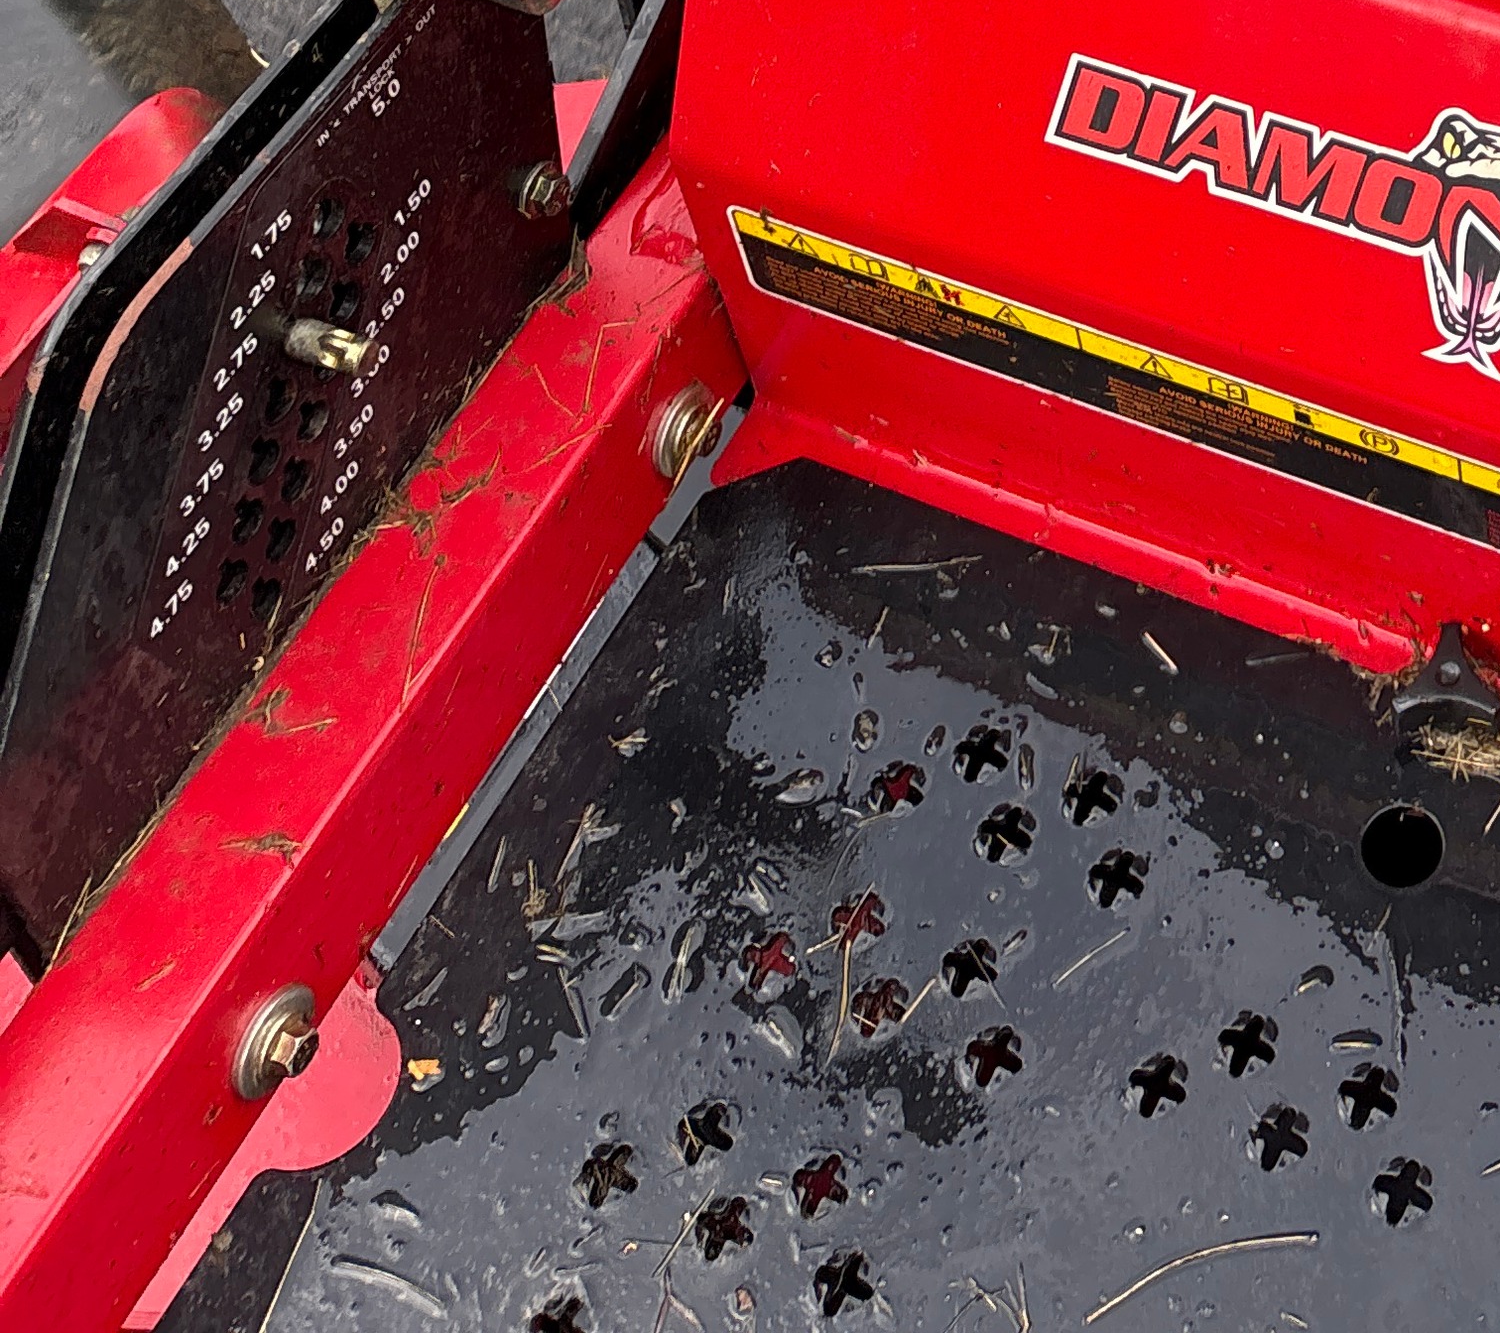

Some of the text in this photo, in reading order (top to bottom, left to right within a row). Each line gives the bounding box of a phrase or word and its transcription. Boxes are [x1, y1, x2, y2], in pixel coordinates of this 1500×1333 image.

[316, 3, 436, 147] IN TRANSPORT OUT
[368, 66, 395, 100] LOCK
[371, 78, 400, 117] 5.0
[394, 179, 431, 226] 1.50
[251, 209, 292, 260] 1.75
[380, 231, 419, 284] 2.00
[230, 269, 276, 329] 2.25
[365, 287, 405, 339] 2.50
[812, 264, 849, 284] AVOID
[849, 278, 901, 303] SERIOUS
[902, 296, 944, 318] INJURY
[945, 311, 964, 325] OR
[965, 318, 1007, 340] DEATH
[213, 332, 258, 392] 2.75
[197, 392, 244, 452] 3.25
[333, 404, 373, 459] 3.50
[1158, 384, 1197, 406] AVOID
[1198, 398, 1253, 425] SERIOUS
[1255, 418, 1300, 442] INJURY
[1302, 434, 1322, 450] OR
[1324, 442, 1368, 465] DEATH
[180, 458, 224, 517] 3.75
[320, 460, 359, 515] 4.00
[166, 517, 210, 577] 4.25
[305, 517, 344, 573] 4.50
[150, 579, 193, 638] 4.75
